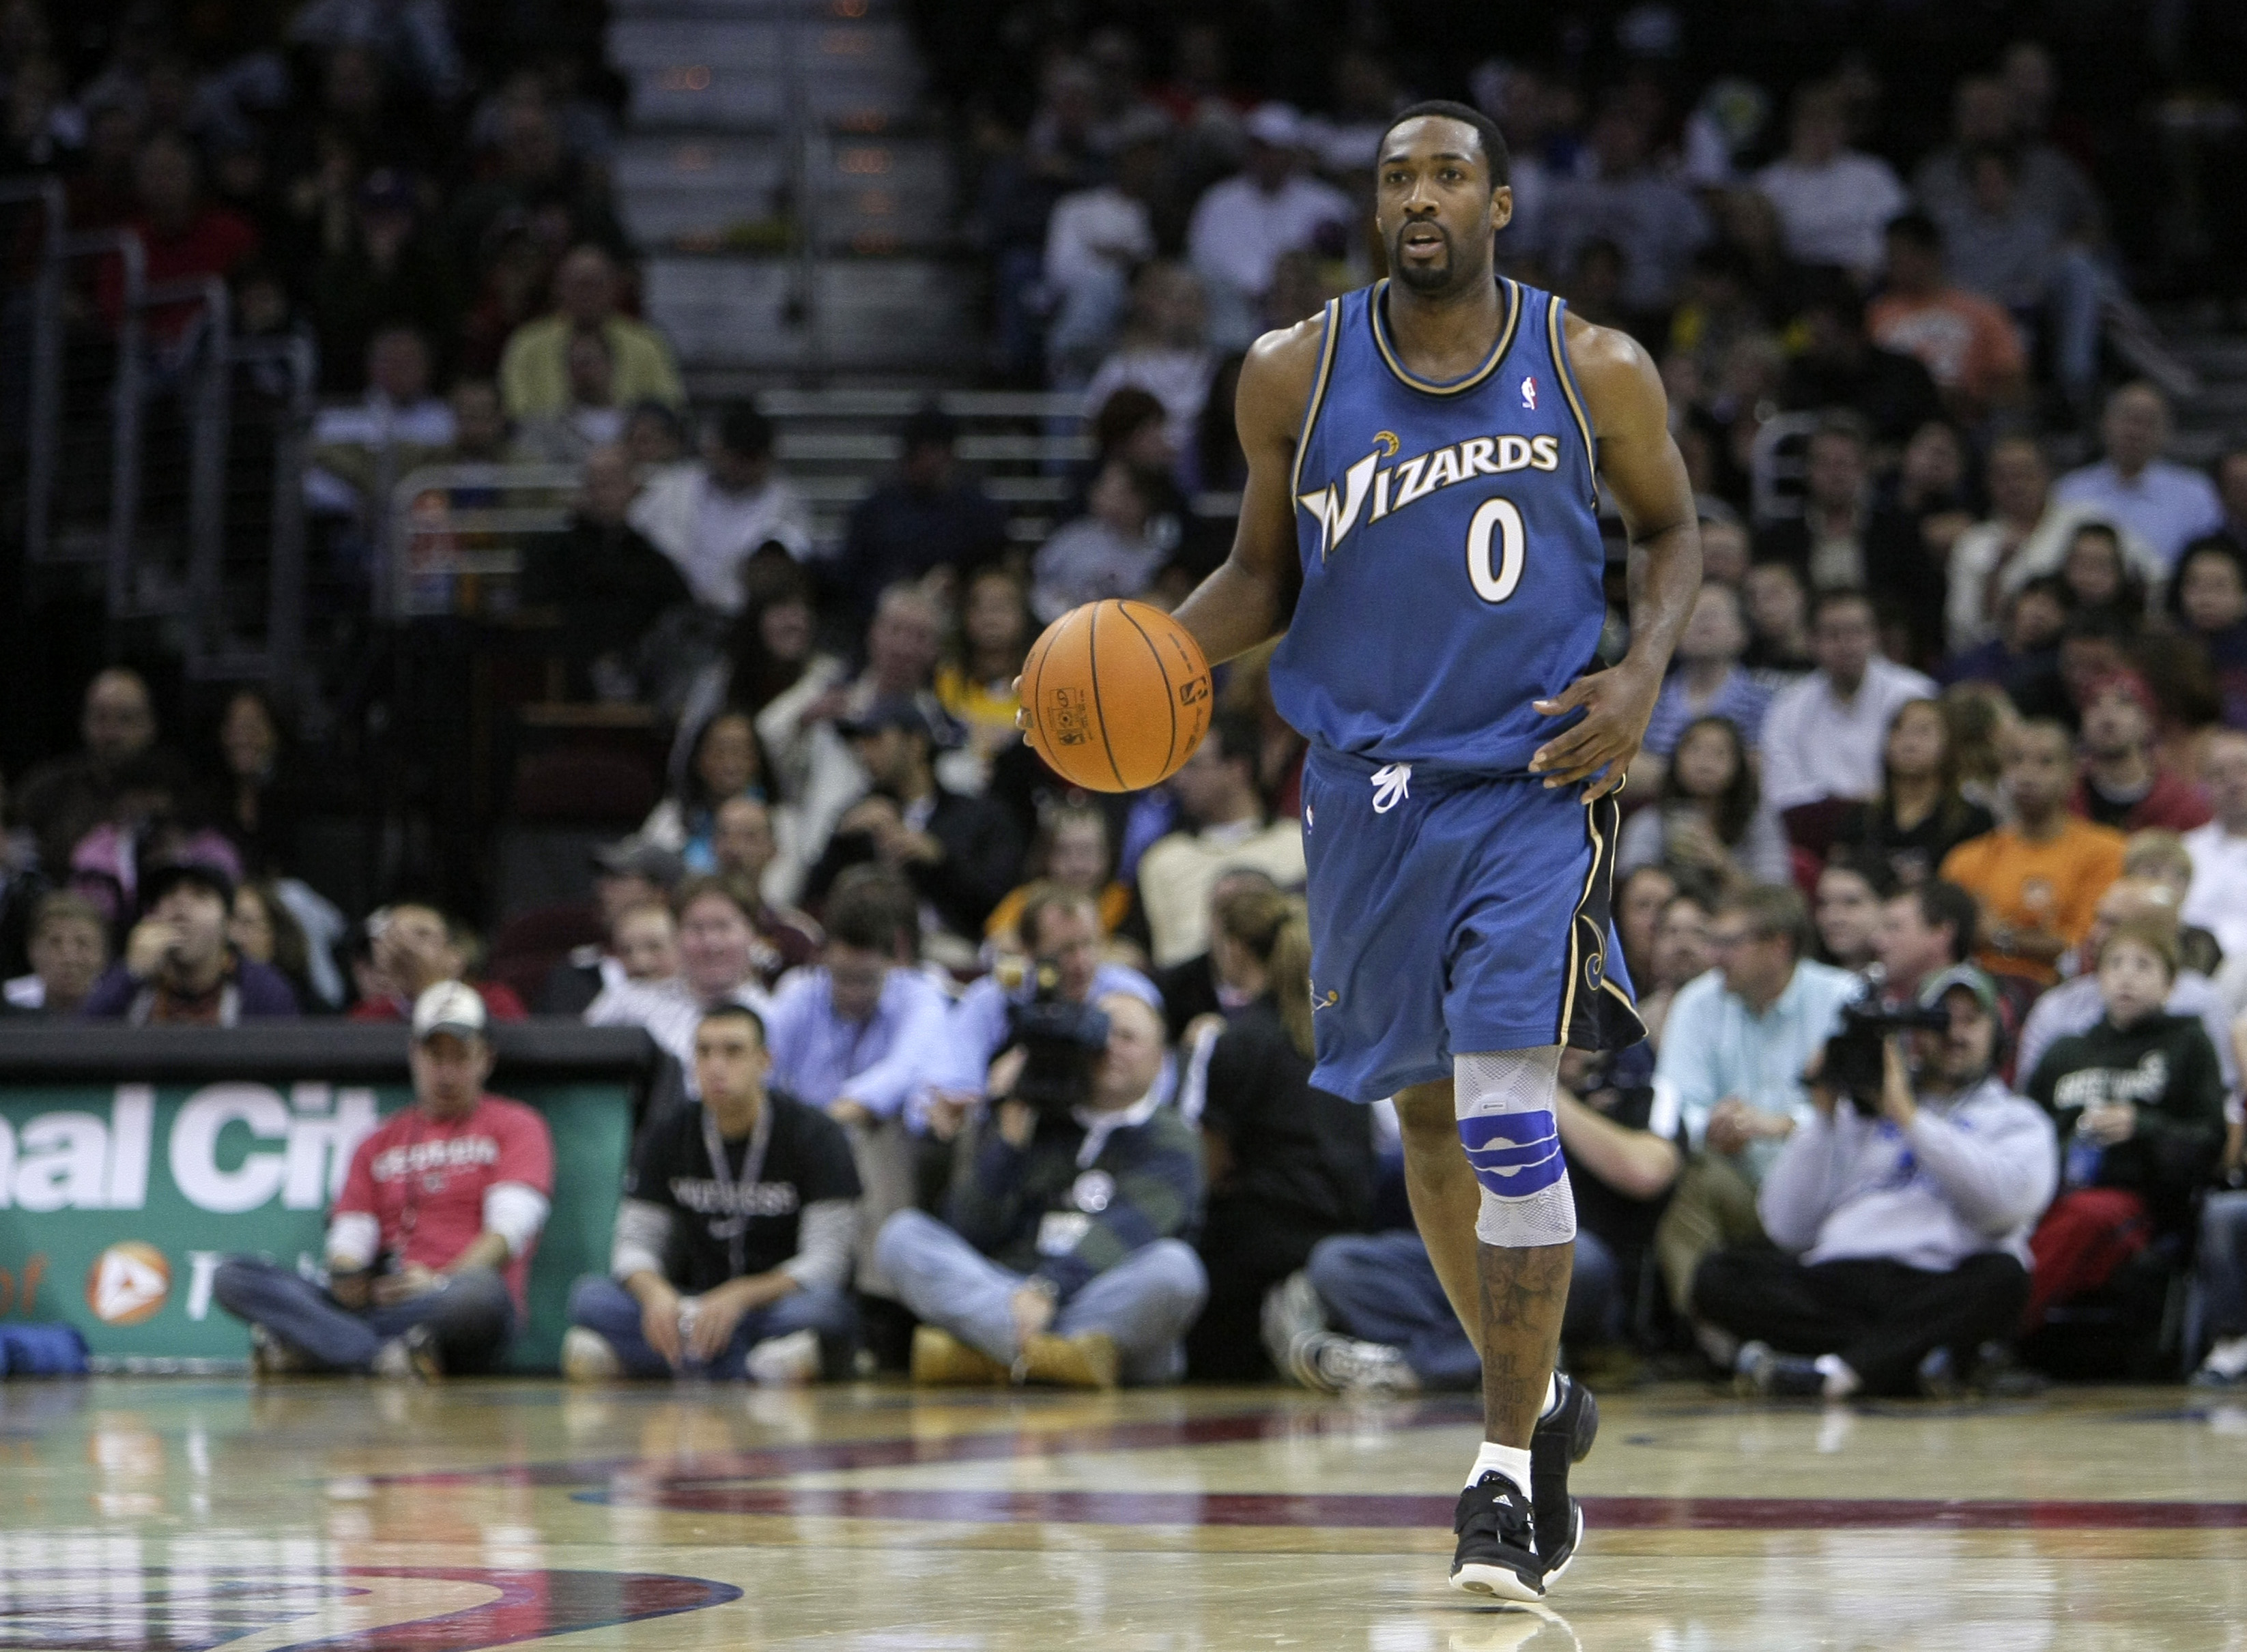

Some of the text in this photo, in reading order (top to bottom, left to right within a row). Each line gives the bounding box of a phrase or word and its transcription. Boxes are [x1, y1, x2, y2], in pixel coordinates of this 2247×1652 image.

[1298, 434, 1558, 564] WIZARDS
[1466, 497, 1526, 603] 0
[169, 1079, 380, 1213] Cit
